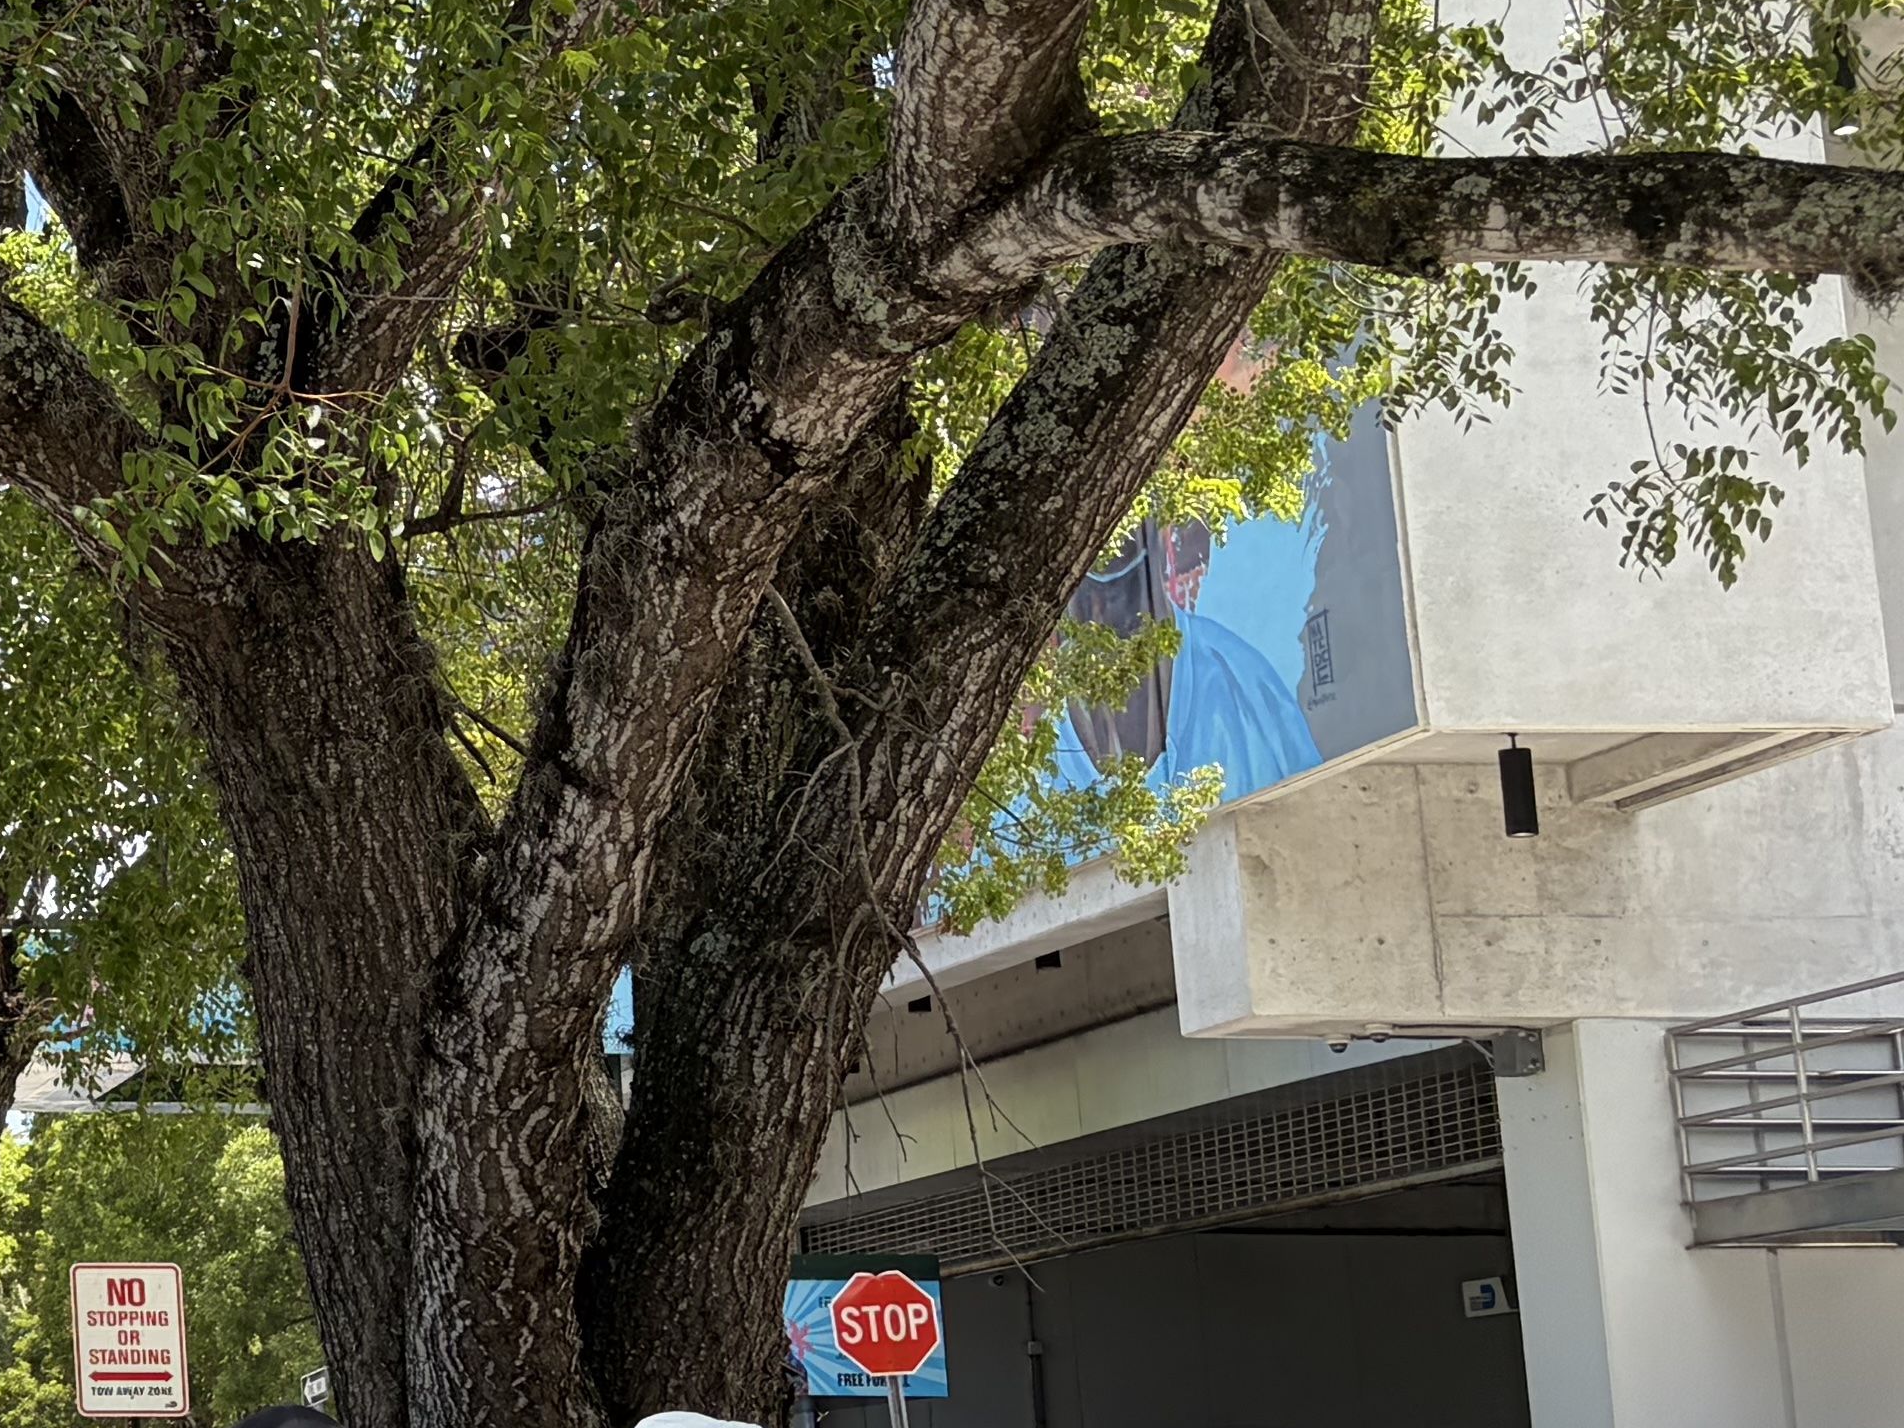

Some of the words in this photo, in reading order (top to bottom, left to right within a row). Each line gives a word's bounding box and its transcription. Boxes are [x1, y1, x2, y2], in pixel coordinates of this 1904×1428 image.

[106, 1278, 146, 1307] NO
[87, 1310, 169, 1327] STOPPING
[840, 1303, 929, 1345] STOP
[117, 1330, 141, 1346] OR
[89, 1349, 171, 1365] STANDING
[837, 1373, 864, 1387] FREE
[91, 1386, 113, 1396] TOW
[116, 1386, 145, 1399] AWAY
[148, 1386, 173, 1396] ZONE
